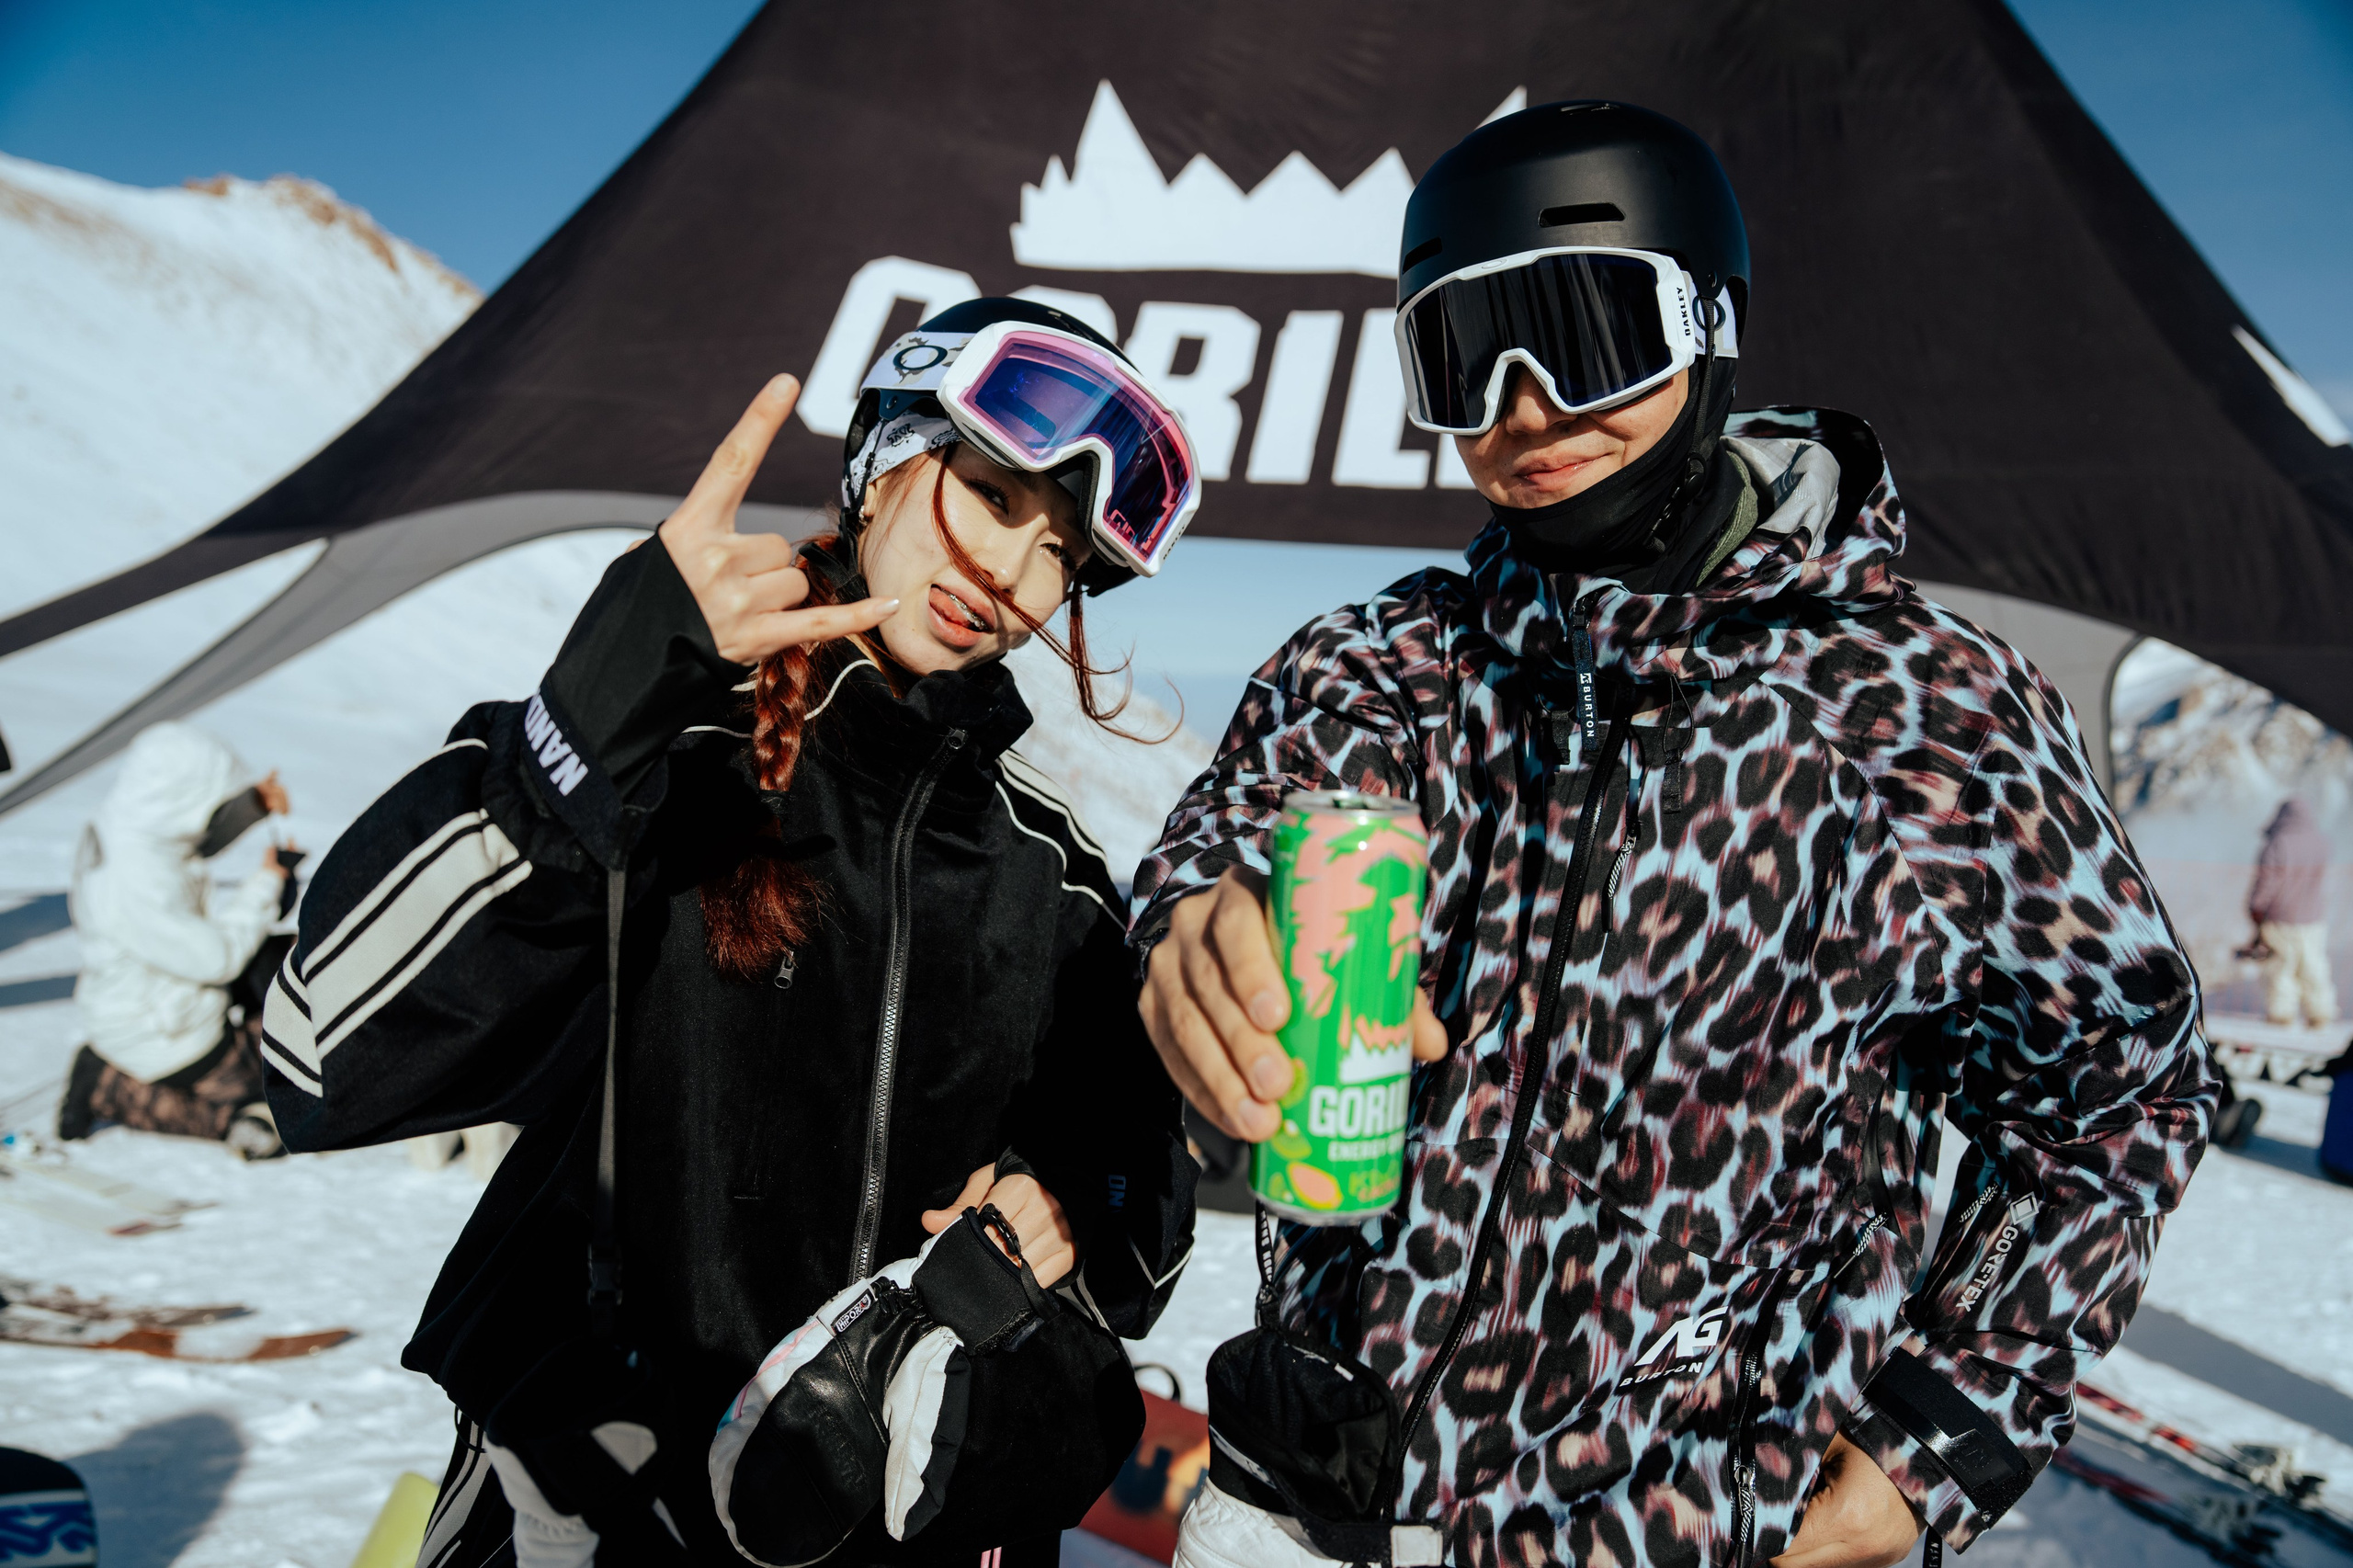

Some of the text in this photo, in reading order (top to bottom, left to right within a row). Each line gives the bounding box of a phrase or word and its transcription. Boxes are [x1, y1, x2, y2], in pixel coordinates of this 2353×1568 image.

[1676, 287, 1692, 336] OAKLEY
[1582, 686, 1595, 737] BURTON
[524, 687, 589, 797] NAND
[1955, 1225, 2019, 1312] GORE-TEX
[1619, 1361, 1703, 1388] BURTON
